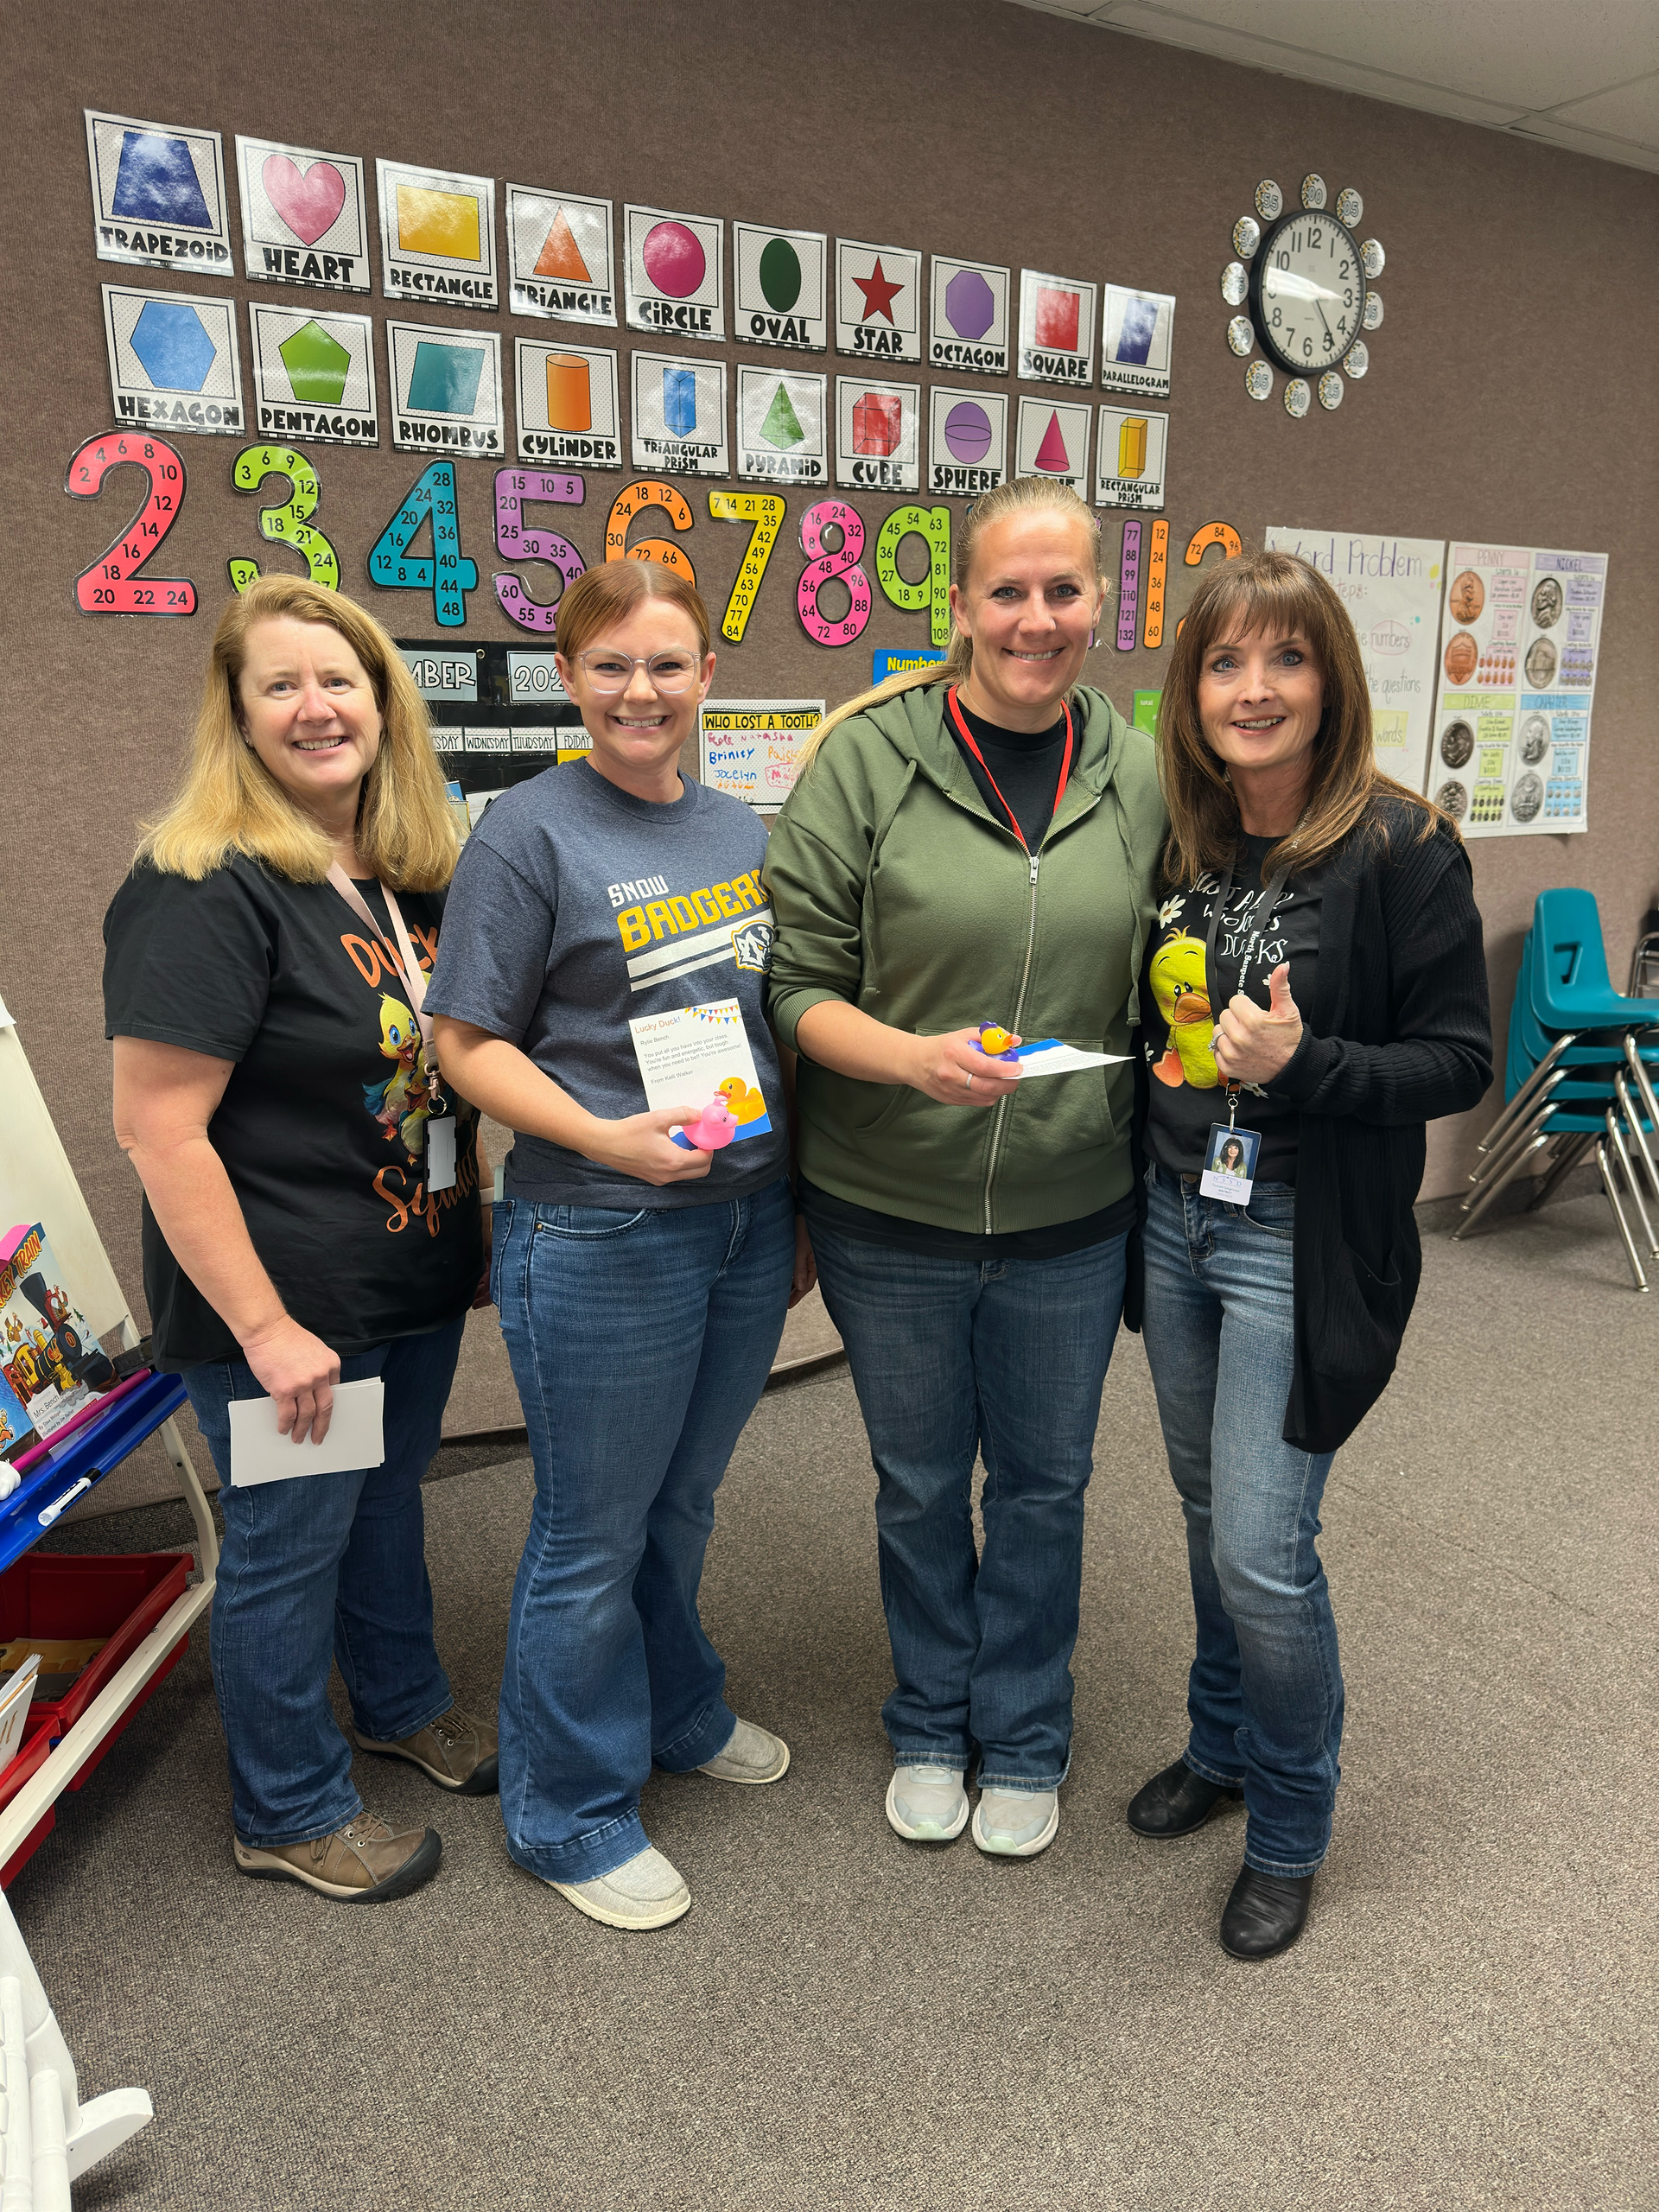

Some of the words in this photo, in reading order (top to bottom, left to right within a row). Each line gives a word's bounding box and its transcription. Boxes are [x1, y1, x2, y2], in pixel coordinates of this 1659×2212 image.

[1262, 192, 1279, 212] 55
[1306, 186, 1324, 205] 00
[1343, 200, 1360, 218] 05
[1291, 231, 1302, 253] 11
[1307, 226, 1322, 250] 12
[1329, 237, 1335, 258] 1
[262, 247, 354, 283] HEART
[1276, 250, 1290, 271] 10
[1338, 259, 1350, 281] 2
[389, 267, 493, 300] RECTANGLE
[1343, 288, 1354, 309] 3
[1271, 307, 1282, 328] 8
[1336, 315, 1347, 335] 4
[750, 314, 810, 344] OVAL
[1285, 327, 1296, 348] 7
[853, 327, 903, 354] STAR
[1302, 336, 1313, 358] 6
[1322, 332, 1334, 353] 5
[932, 343, 1006, 368] OCTAGON
[1022, 353, 1088, 380] SQUARE
[1103, 369, 1170, 390] PARALLELOGRAM
[118, 396, 240, 426] HEXAGON
[260, 408, 376, 439] PENTAGON
[398, 420, 499, 449] RHOMBUS
[95, 447, 106, 463] 4
[118, 439, 128, 455] 6
[143, 443, 155, 459] 8
[79, 466, 92, 483] 2
[158, 464, 178, 480] 10
[432, 472, 452, 486] 28
[851, 461, 903, 486] CUBE
[933, 465, 1001, 492] SPHERE
[414, 487, 432, 503] 24
[1100, 479, 1160, 495] RECTANGULAR
[154, 495, 173, 512] 12
[435, 500, 454, 515] 32
[713, 497, 721, 509] 7
[726, 498, 737, 511] 14
[744, 499, 756, 512] 21
[761, 499, 776, 512] 28
[65, 429, 199, 617] 2
[226, 442, 343, 594] 3
[400, 511, 419, 525] 20
[762, 515, 777, 527] 35
[140, 522, 159, 537] 14
[437, 525, 456, 540] 36
[756, 531, 771, 543] 42
[366, 458, 480, 628] 4
[388, 532, 404, 547] 16
[122, 543, 141, 560] 16
[492, 466, 588, 635] 5
[752, 547, 766, 559] 49
[1348, 539, 1423, 578] Problem
[1477, 549, 1504, 567] PENNY
[376, 555, 393, 569] 12
[439, 554, 458, 569] 40
[708, 488, 789, 645] 7
[745, 563, 759, 575] 56
[1556, 556, 1584, 572] NICKEL
[101, 564, 121, 581] 18
[397, 567, 407, 582] 8
[416, 568, 427, 582] 4
[796, 498, 873, 649] 8
[875, 503, 952, 648] 9
[440, 579, 459, 594] 44
[741, 579, 753, 591] 63
[92, 588, 116, 605] 20
[133, 589, 155, 606] 22
[166, 589, 188, 606] 24
[734, 594, 748, 607] 70
[441, 602, 461, 616] 48
[729, 609, 743, 621] 77
[726, 625, 740, 637] 84
[1370, 620, 1410, 649] numbers
[1382, 667, 1421, 704] questions
[1463, 695, 1491, 709] DIME
[705, 715, 730, 728] WHO
[735, 715, 762, 728] LOST
[767, 715, 775, 729] A
[780, 713, 820, 728] TOOTH?
[1375, 715, 1403, 744] words
[433, 735, 459, 750] SDAY
[466, 737, 510, 750] WEDNESDAY
[512, 735, 554, 749] THURSDAY
[563, 735, 591, 749] FRIDAY
[713, 769, 757, 781] Jocelyn
[607, 874, 670, 908] SNOW
[1220, 933, 1288, 964] DUKS
[1247, 930, 1262, 956] North
[1237, 951, 1254, 988] Sanpete
[634, 1022, 658, 1034] Lucky
[658, 1016, 681, 1028] Duck!
[640, 1038, 653, 1046] Rylie
[653, 1034, 670, 1043] Bench
[645, 1057, 662, 1065] You're
[714, 1039, 728, 1048] tough
[646, 1064, 662, 1072] when
[700, 1050, 717, 1058] You're
[651, 1077, 664, 1085] From
[676, 1070, 694, 1078] Walker
[11, 1230, 43, 1280] TRAIN
[33, 1408, 46, 1419] Mrs.
[43, 1394, 60, 1410] Bench
